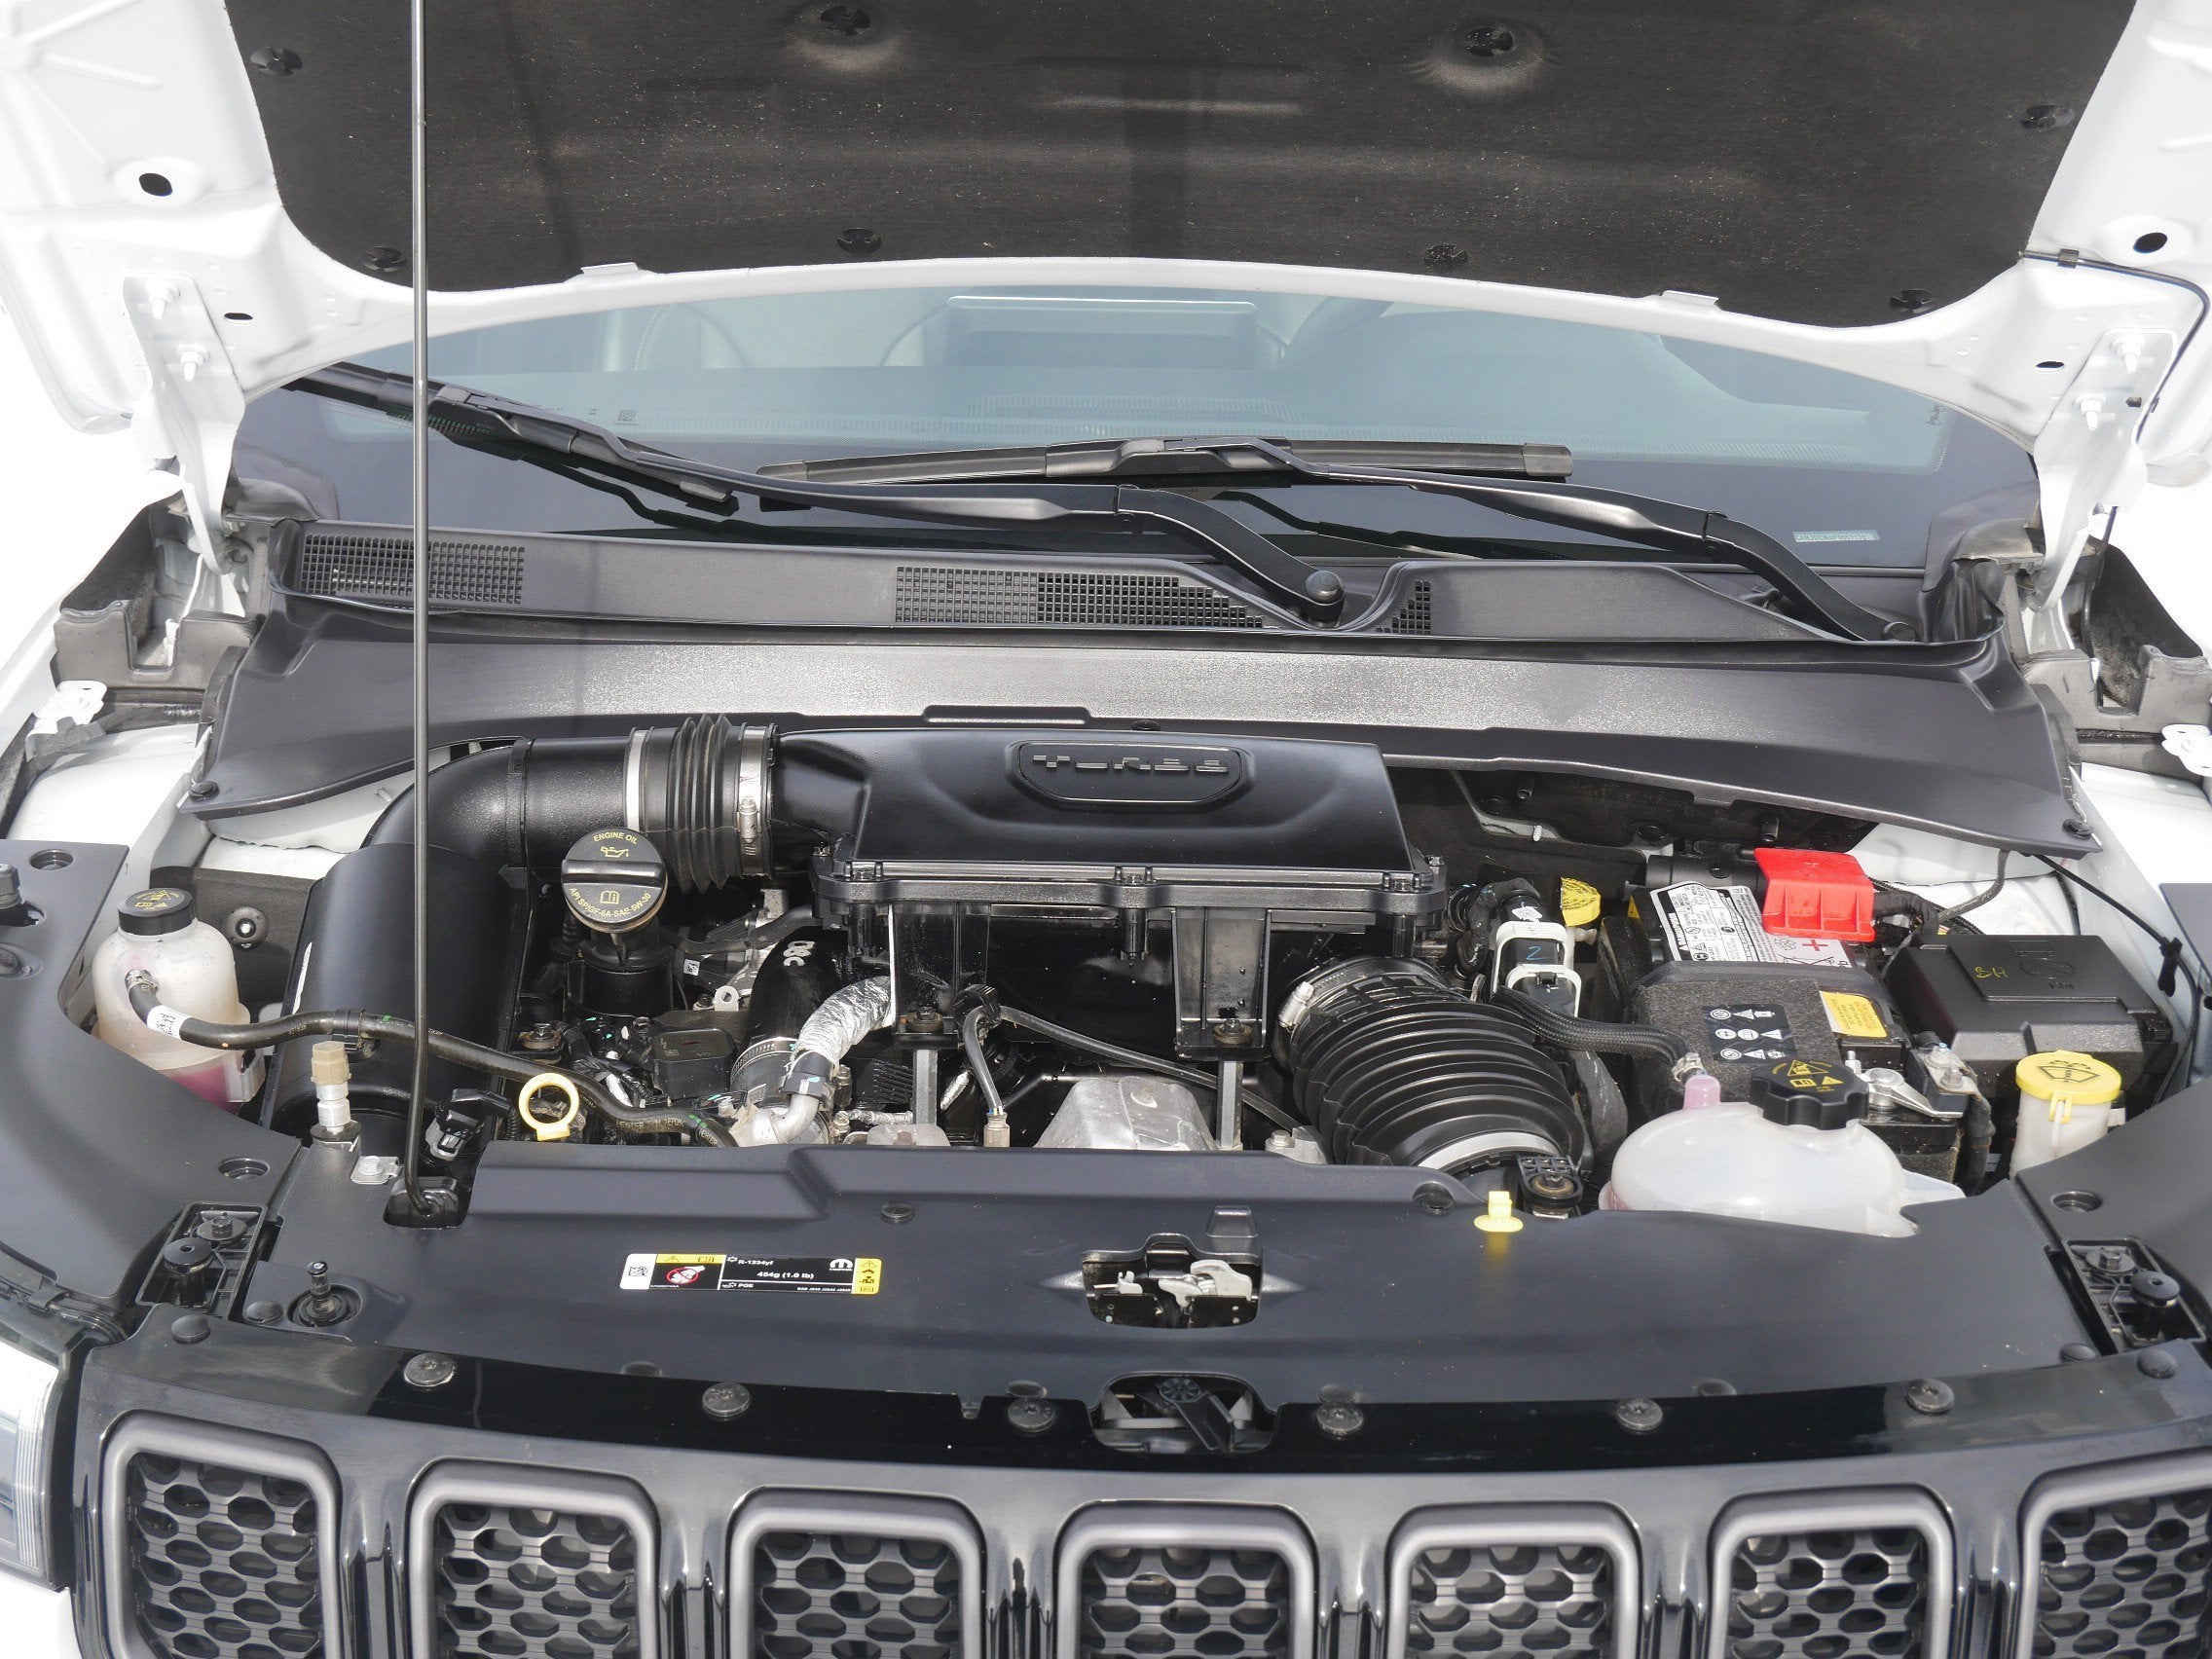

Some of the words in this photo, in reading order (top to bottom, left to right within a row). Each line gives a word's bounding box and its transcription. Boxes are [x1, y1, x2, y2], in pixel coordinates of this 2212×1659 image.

[593, 831, 624, 842] ENGINE
[626, 834, 638, 845] OIL
[570, 887, 581, 901] API
[631, 893, 651, 911] 5W-30
[1526, 946, 1542, 961] 2
